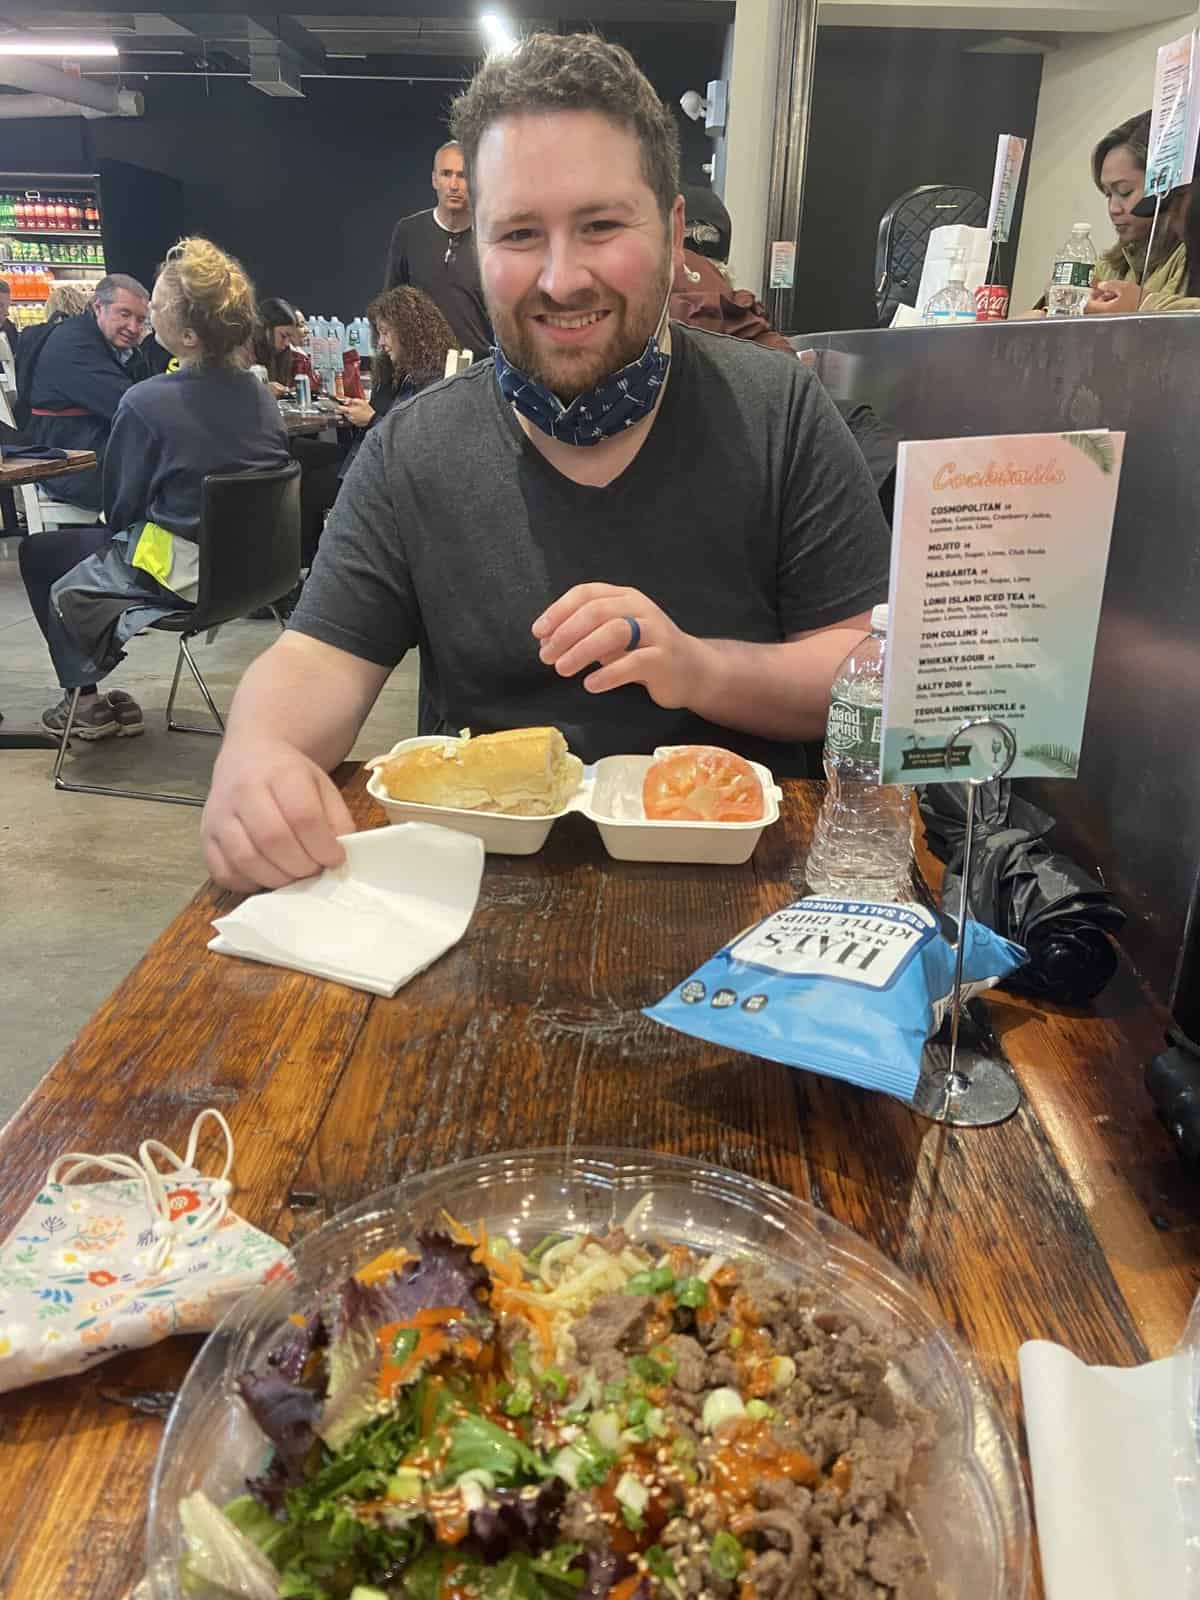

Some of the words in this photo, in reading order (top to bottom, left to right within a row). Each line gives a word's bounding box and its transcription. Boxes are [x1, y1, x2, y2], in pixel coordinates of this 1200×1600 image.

[931, 502, 1001, 516] COSMOPOLITAN
[927, 542, 961, 553] MOJITO
[926, 568, 977, 580] MARGARITA
[923, 596, 947, 607] LONG
[948, 594, 982, 605] ISLAND
[983, 593, 1005, 603] ICED
[1006, 592, 1025, 601] TEA
[920, 631, 939, 641] TOM
[940, 628, 978, 639] COLLINS
[960, 653, 985, 663] SOUR
[916, 681, 943, 692] SALTY
[944, 680, 963, 690] DOG
[828, 704, 860, 725] Poland
[914, 706, 950, 718] TEQUILA
[951, 702, 1017, 714] HONEYSUCKLE
[847, 903, 859, 912] &
[861, 905, 897, 918] SALT
[773, 912, 832, 926] CHIPS
[898, 911, 926, 930] SEA
[780, 924, 831, 934] YORK
[834, 917, 913, 940] KETTLE
[845, 930, 889, 947] NEW
